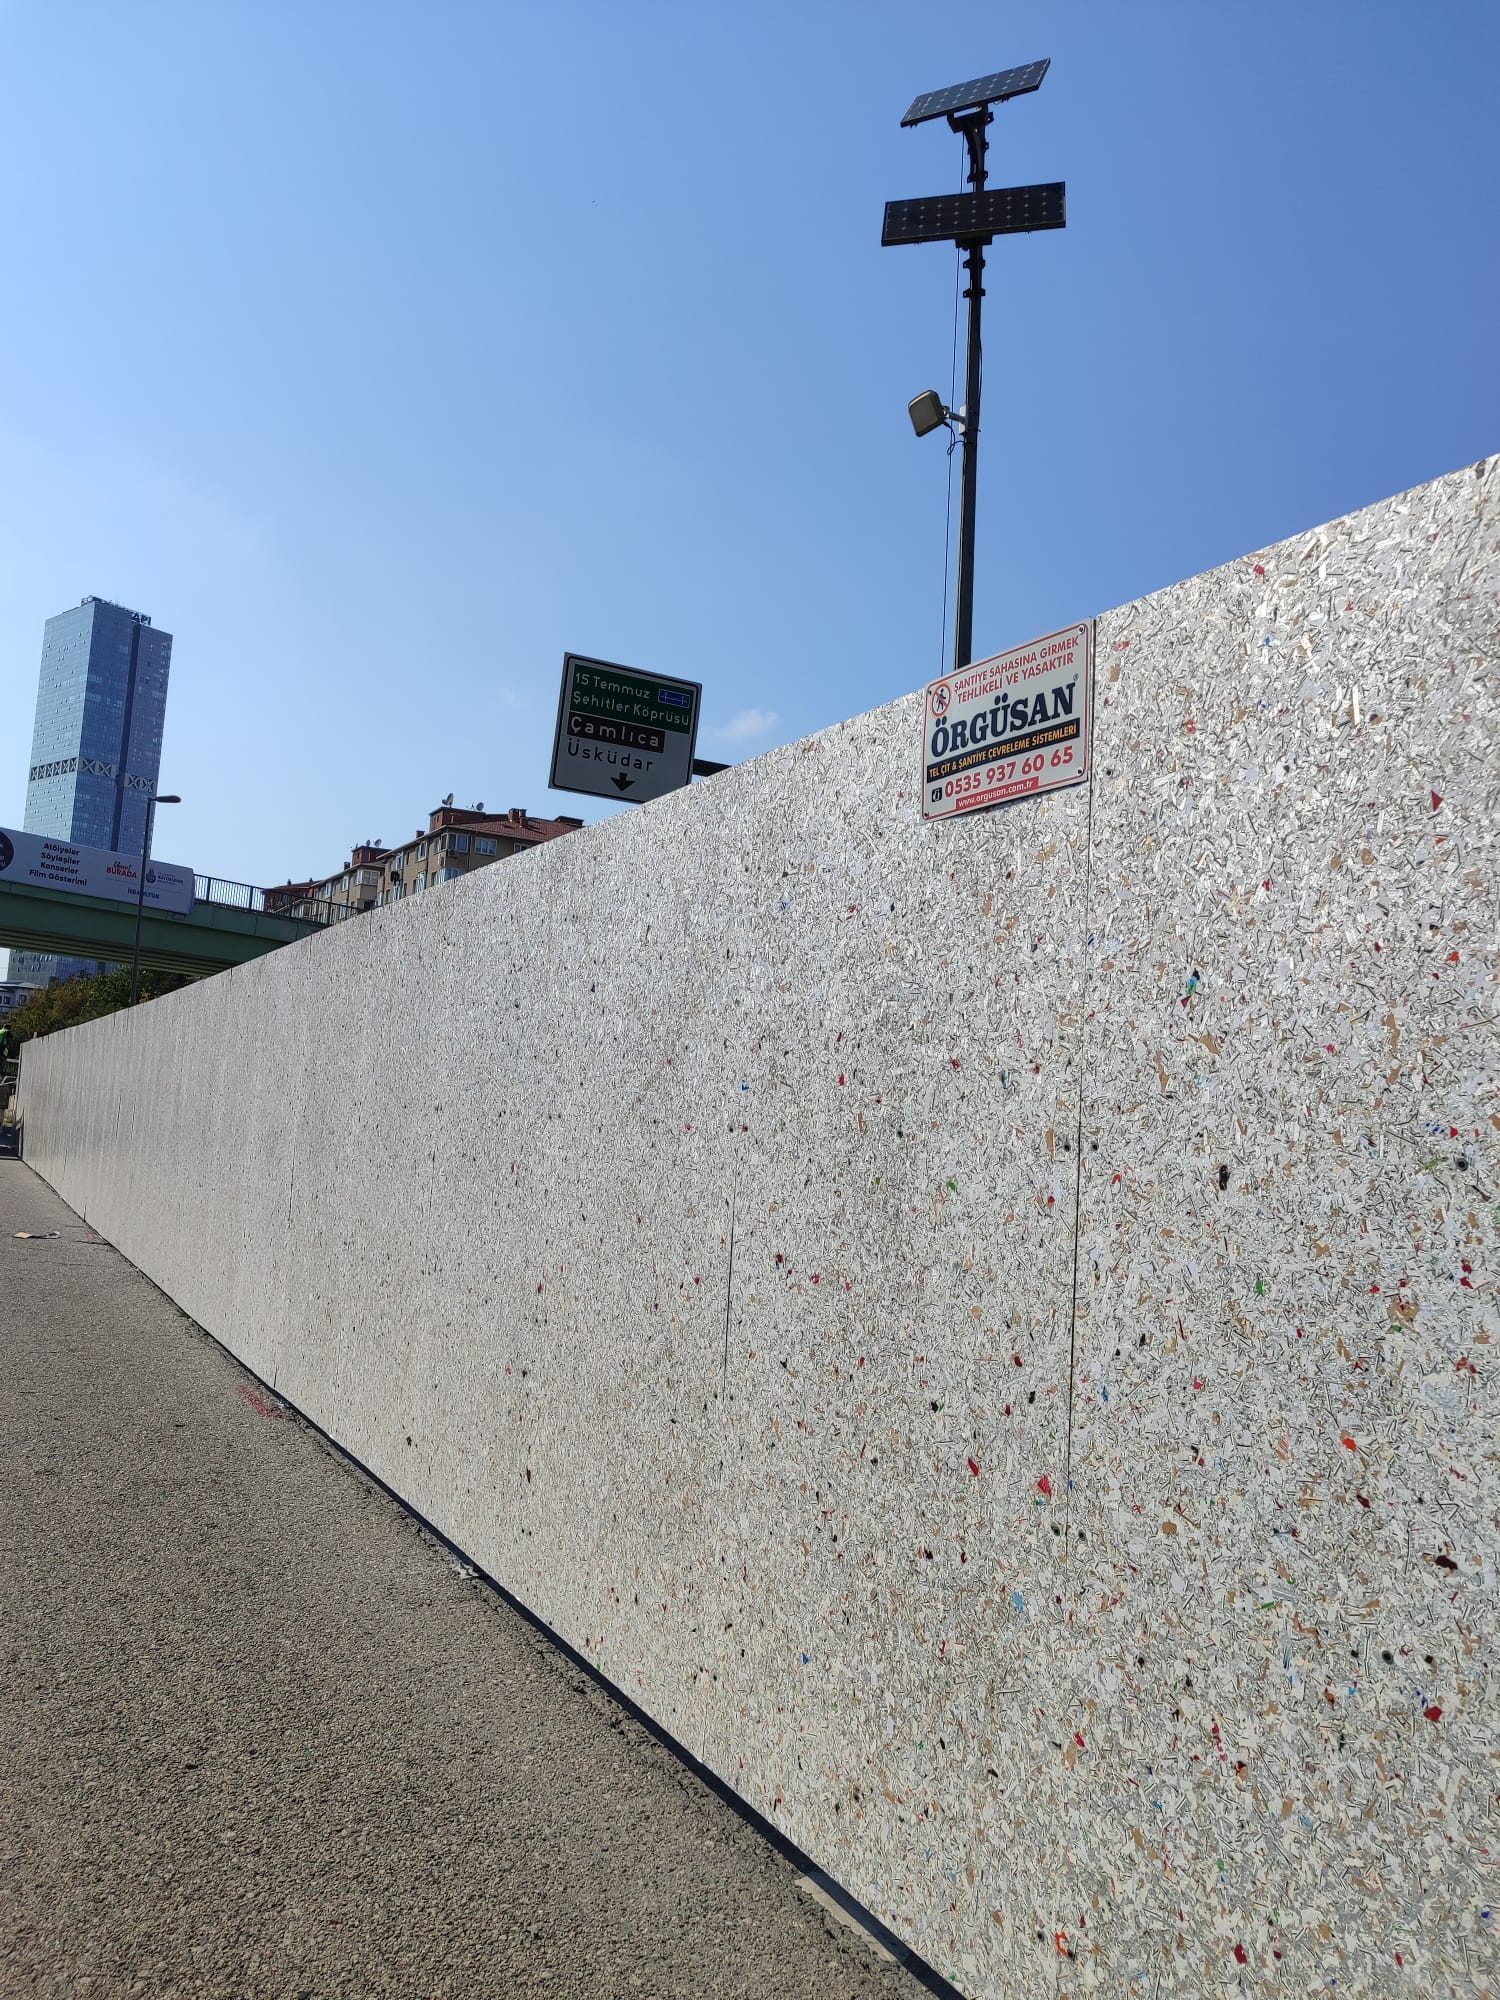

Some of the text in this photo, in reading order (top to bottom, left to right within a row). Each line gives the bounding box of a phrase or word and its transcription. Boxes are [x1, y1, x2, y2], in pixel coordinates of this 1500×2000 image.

[954, 636, 1079, 693] ŞANTİYE SAHASINA GİRMEK
[957, 652, 1074, 704] TEHLİKELİ VE YASAKTIR
[575, 672, 651, 699] 15 Temmuz
[573, 691, 630, 713] Şehitler
[570, 716, 660, 747] Çamlıca
[931, 682, 1076, 757] ÖRGÜSAN
[567, 738, 654, 772] Üsküdar
[929, 768, 940, 778] TEL
[940, 765, 950, 777] ÇİT
[958, 751, 986, 770] ŞANTİYE
[988, 737, 1031, 760] ÇEVRELEME
[1032, 723, 1077, 745] SİSTEMLERİ
[944, 745, 1073, 798] 0535 937 60 65
[41, 852, 81, 866] Söyleşiler
[43, 843, 80, 856] Atölyeler
[29, 869, 88, 887] Film Gösterimi
[40, 862, 79, 875] Konserler
[106, 867, 137, 878] BURADA
